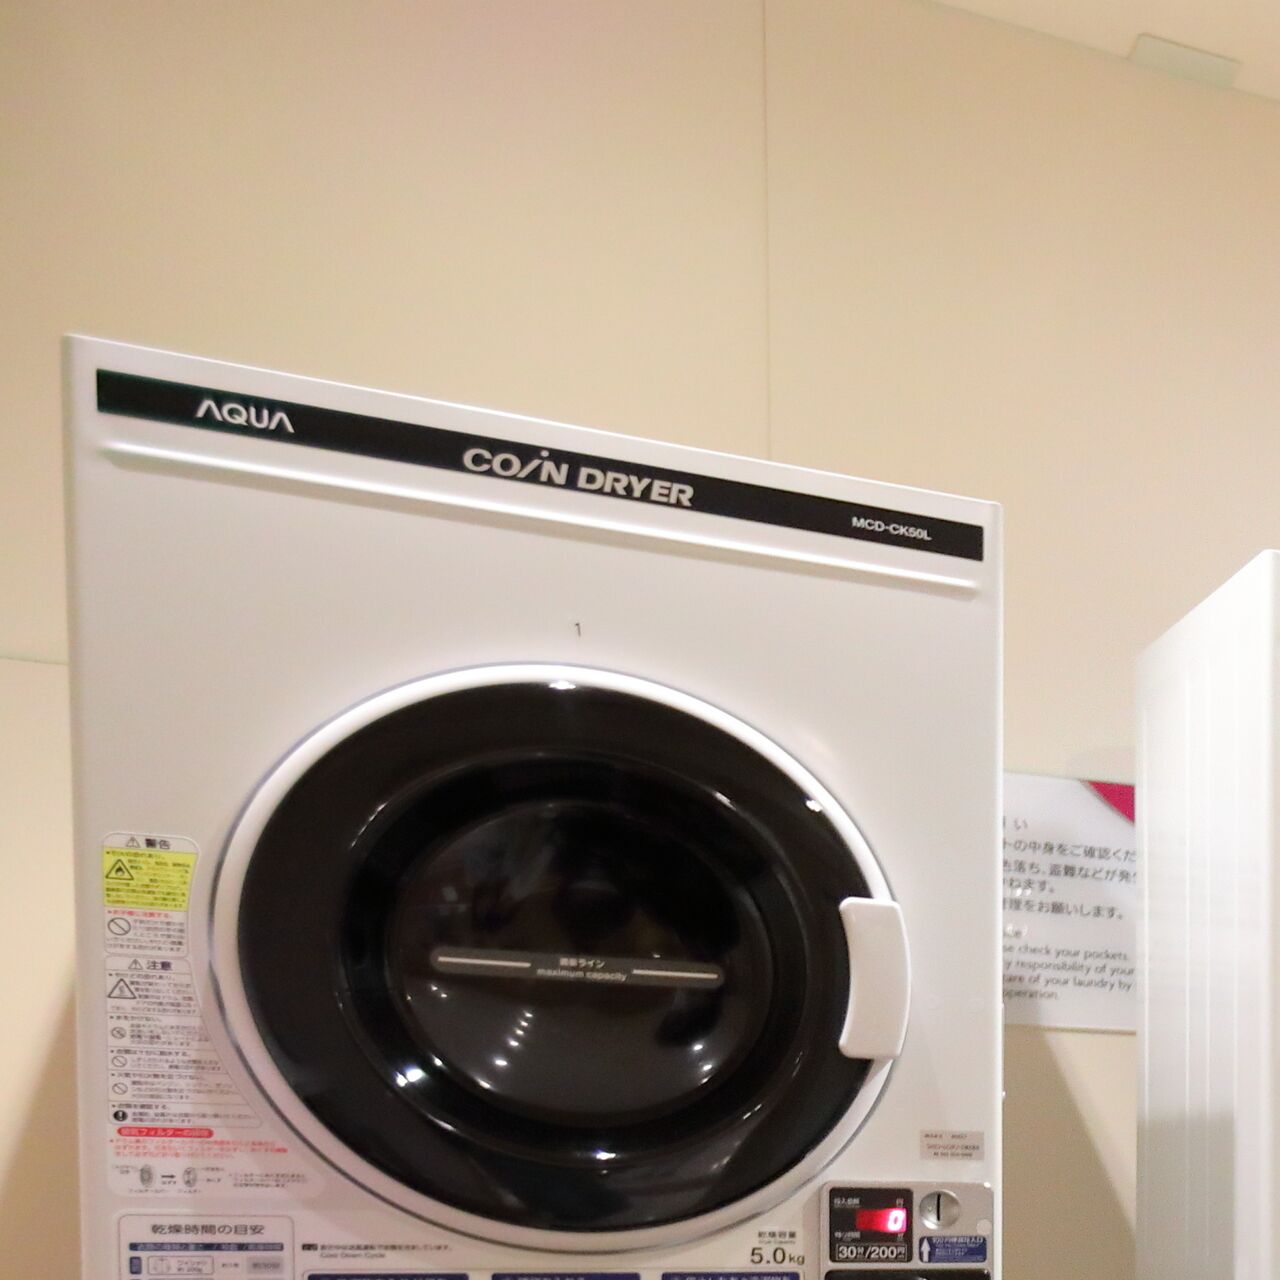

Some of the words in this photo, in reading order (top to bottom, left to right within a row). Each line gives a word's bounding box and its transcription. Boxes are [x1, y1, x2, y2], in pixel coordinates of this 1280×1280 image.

[196, 399, 295, 434] AQUA
[577, 465, 695, 507] DRYER
[851, 515, 933, 543] MCD-CK50L
[574, 621, 581, 637] 1
[1018, 943, 1051, 956] check
[1055, 948, 1080, 960] your
[146, 960, 173, 971] 注意
[1016, 960, 1092, 975] responsibility
[1095, 964, 1107, 974] of
[1110, 966, 1135, 978] your
[536, 967, 584, 979] maximum
[585, 970, 627, 983] capacity
[1028, 975, 1040, 985] of
[1044, 976, 1070, 989] your
[1073, 975, 1115, 992] laundry
[1119, 981, 1132, 993] by
[887, 1208, 906, 1233] 0
[151, 1224, 265, 1236] 乾燥時間の目安
